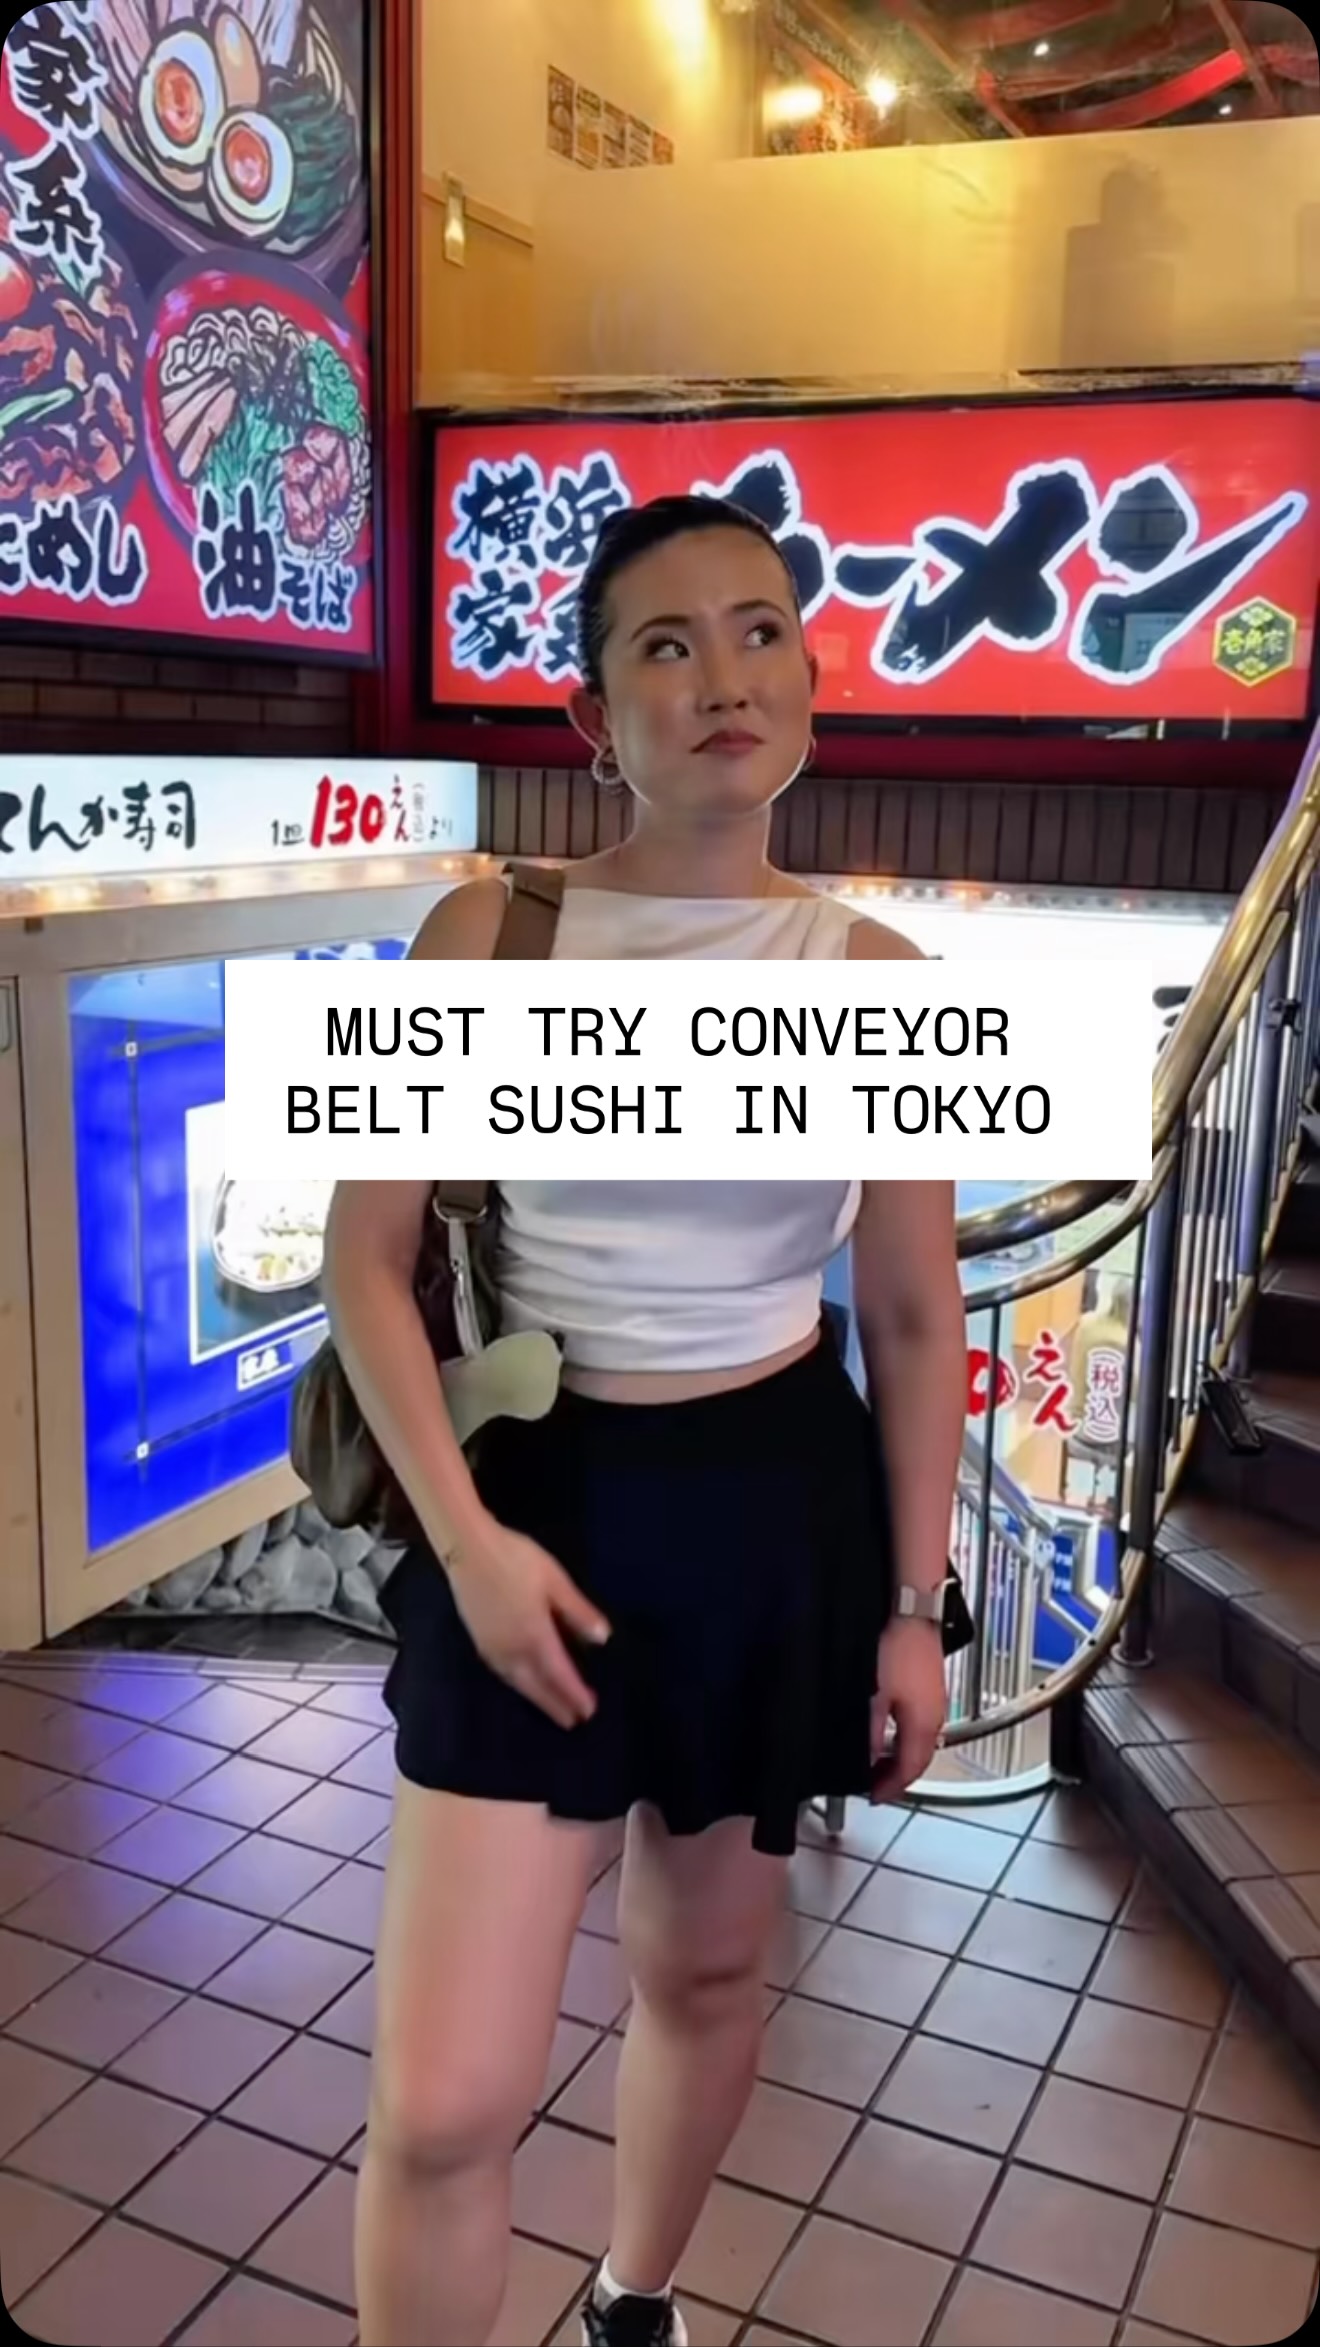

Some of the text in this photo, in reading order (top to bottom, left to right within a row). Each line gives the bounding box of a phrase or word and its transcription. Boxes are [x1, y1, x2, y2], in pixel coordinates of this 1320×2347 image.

[194, 482, 355, 630] 油そば
[310, 775, 385, 848] 130
[1026, 1330, 1078, 1433] えん
